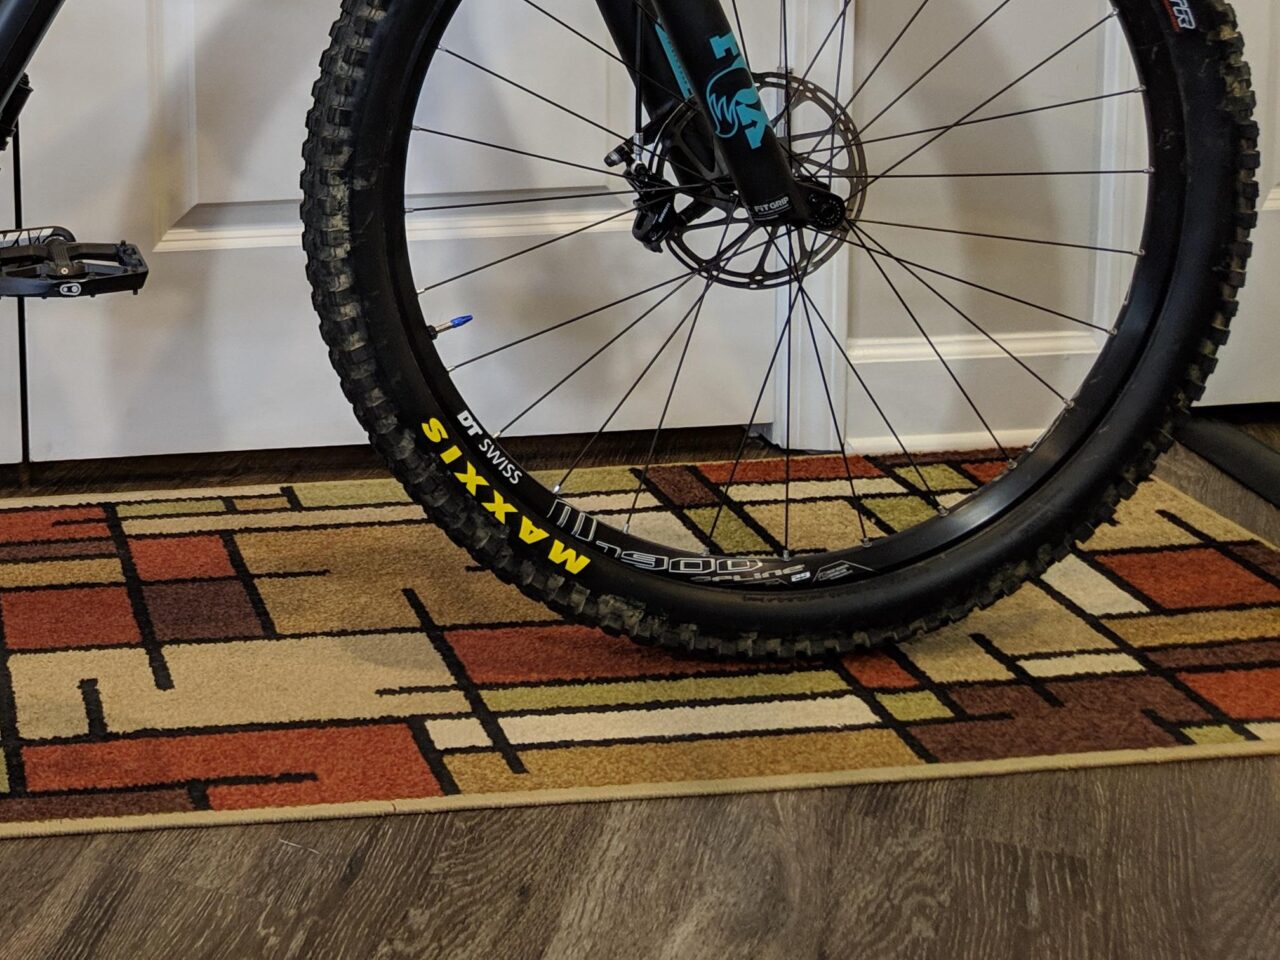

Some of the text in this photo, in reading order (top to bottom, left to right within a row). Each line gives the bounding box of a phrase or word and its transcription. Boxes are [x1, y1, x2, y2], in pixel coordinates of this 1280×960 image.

[422, 417, 592, 575] MAXXIS
[457, 410, 524, 485] DT SWISS
